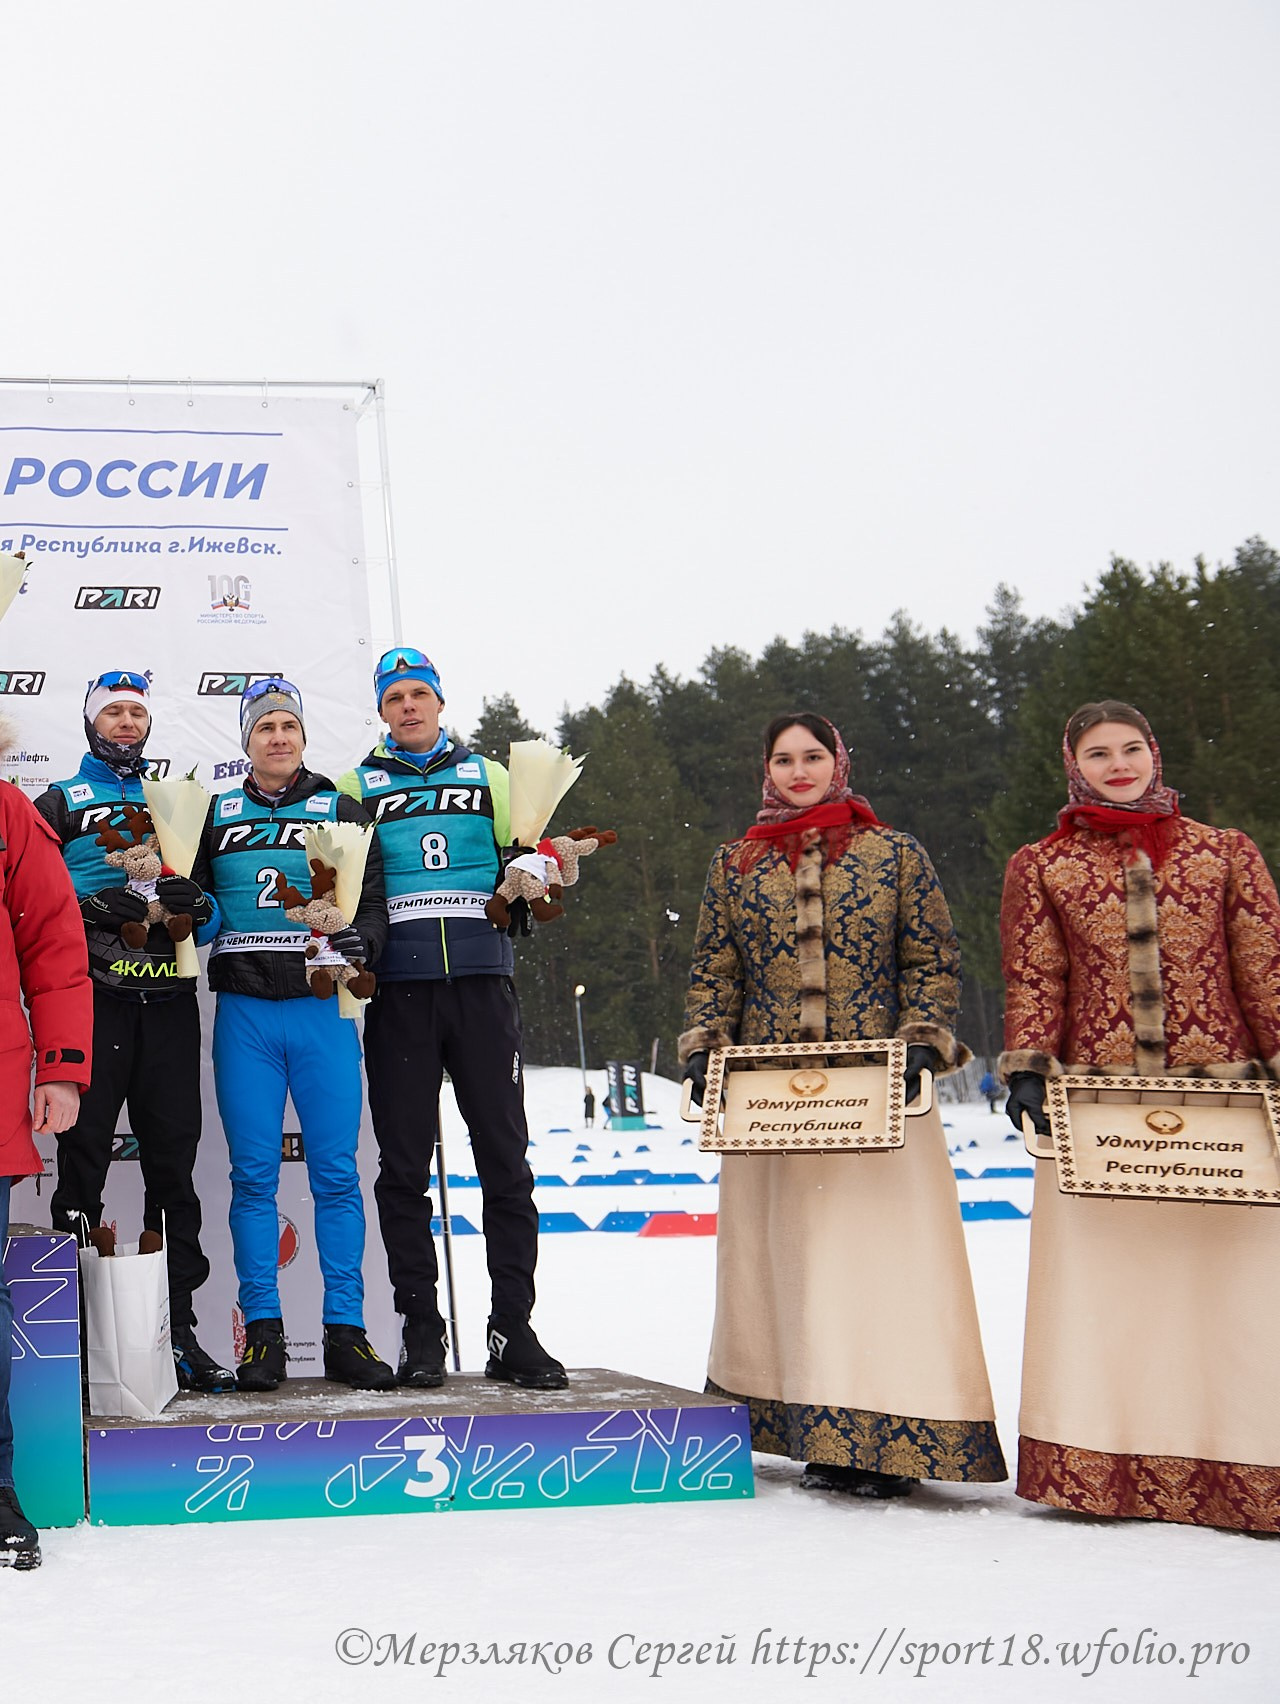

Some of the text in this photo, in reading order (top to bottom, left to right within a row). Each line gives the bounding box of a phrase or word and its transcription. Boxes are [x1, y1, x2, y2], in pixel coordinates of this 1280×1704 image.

[3, 458, 269, 501] РОССИИ
[20, 534, 162, 559] Республика
[168, 536, 283, 556] г.Ижевск.
[77, 587, 158, 608] PARI
[376, 788, 481, 820] PARI
[218, 822, 307, 851] PAR
[420, 831, 450, 871] 8
[256, 867, 282, 909] 2
[388, 896, 468, 911] ЧЕМПИОНАТ
[226, 935, 301, 946] ЧЕМПИОНАТ
[745, 1095, 869, 1114] Удмуртская
[748, 1117, 863, 1135] Республика
[1095, 1133, 1244, 1155] Удмуртская
[1105, 1159, 1244, 1180] Республика
[404, 1434, 450, 1497] 3
